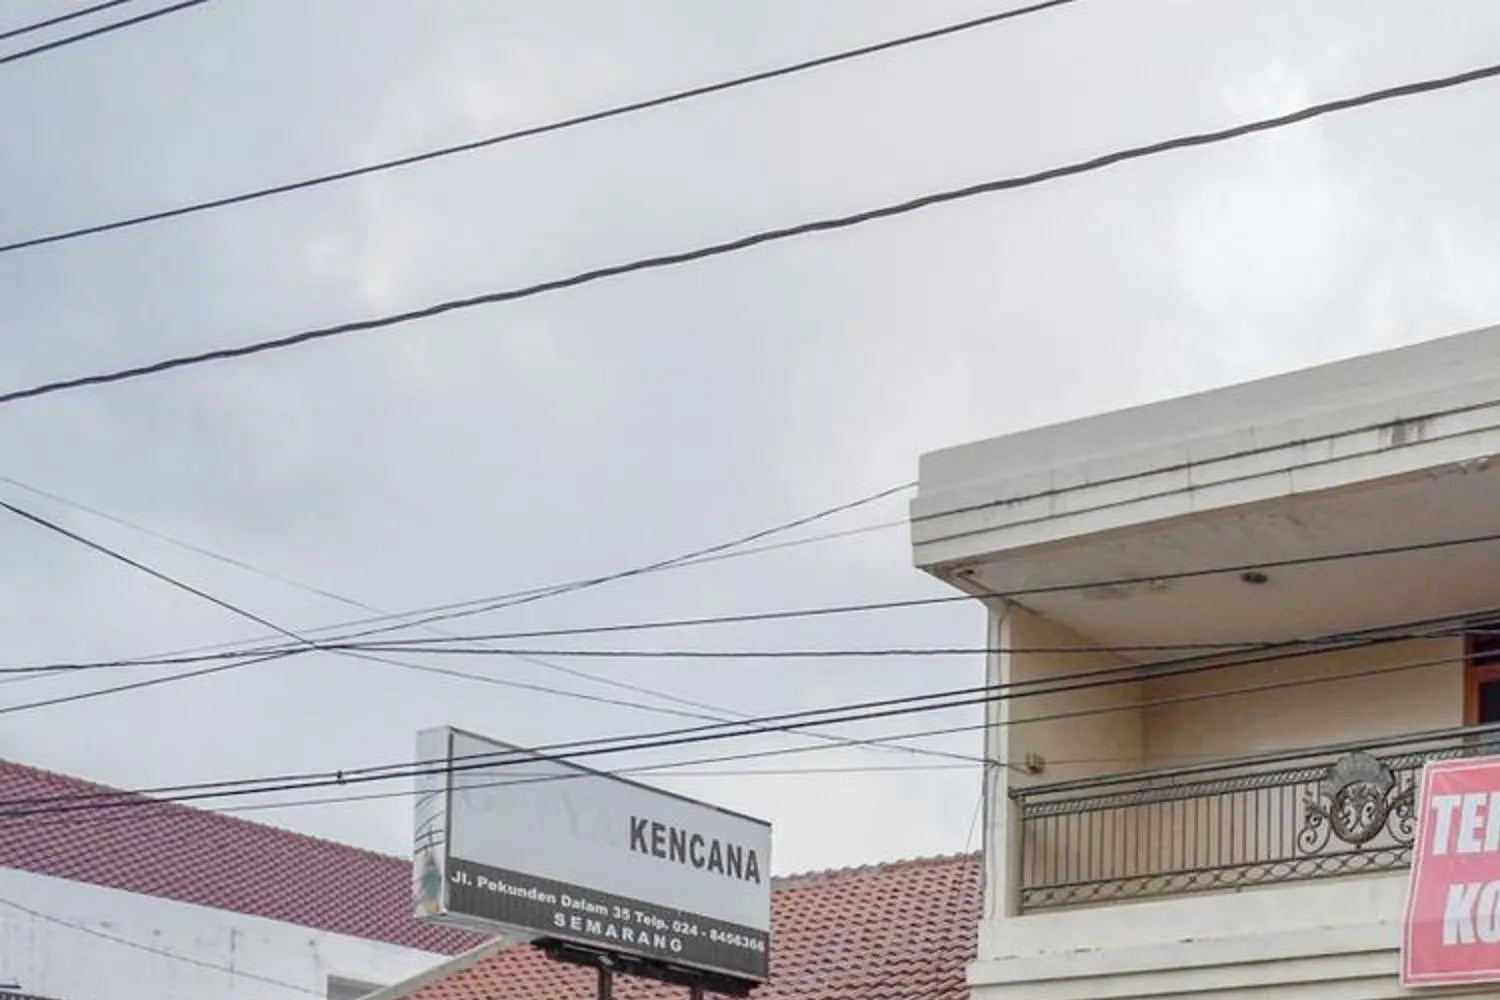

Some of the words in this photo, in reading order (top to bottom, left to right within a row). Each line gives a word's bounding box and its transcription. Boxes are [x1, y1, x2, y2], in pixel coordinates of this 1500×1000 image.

[629, 815, 761, 884] KENCANA
[477, 875, 557, 904] Pekunden
[561, 894, 609, 916] Dalam
[634, 911, 669, 930] Telp.
[672, 920, 699, 937] 024
[553, 912, 683, 953] SEMARANG
